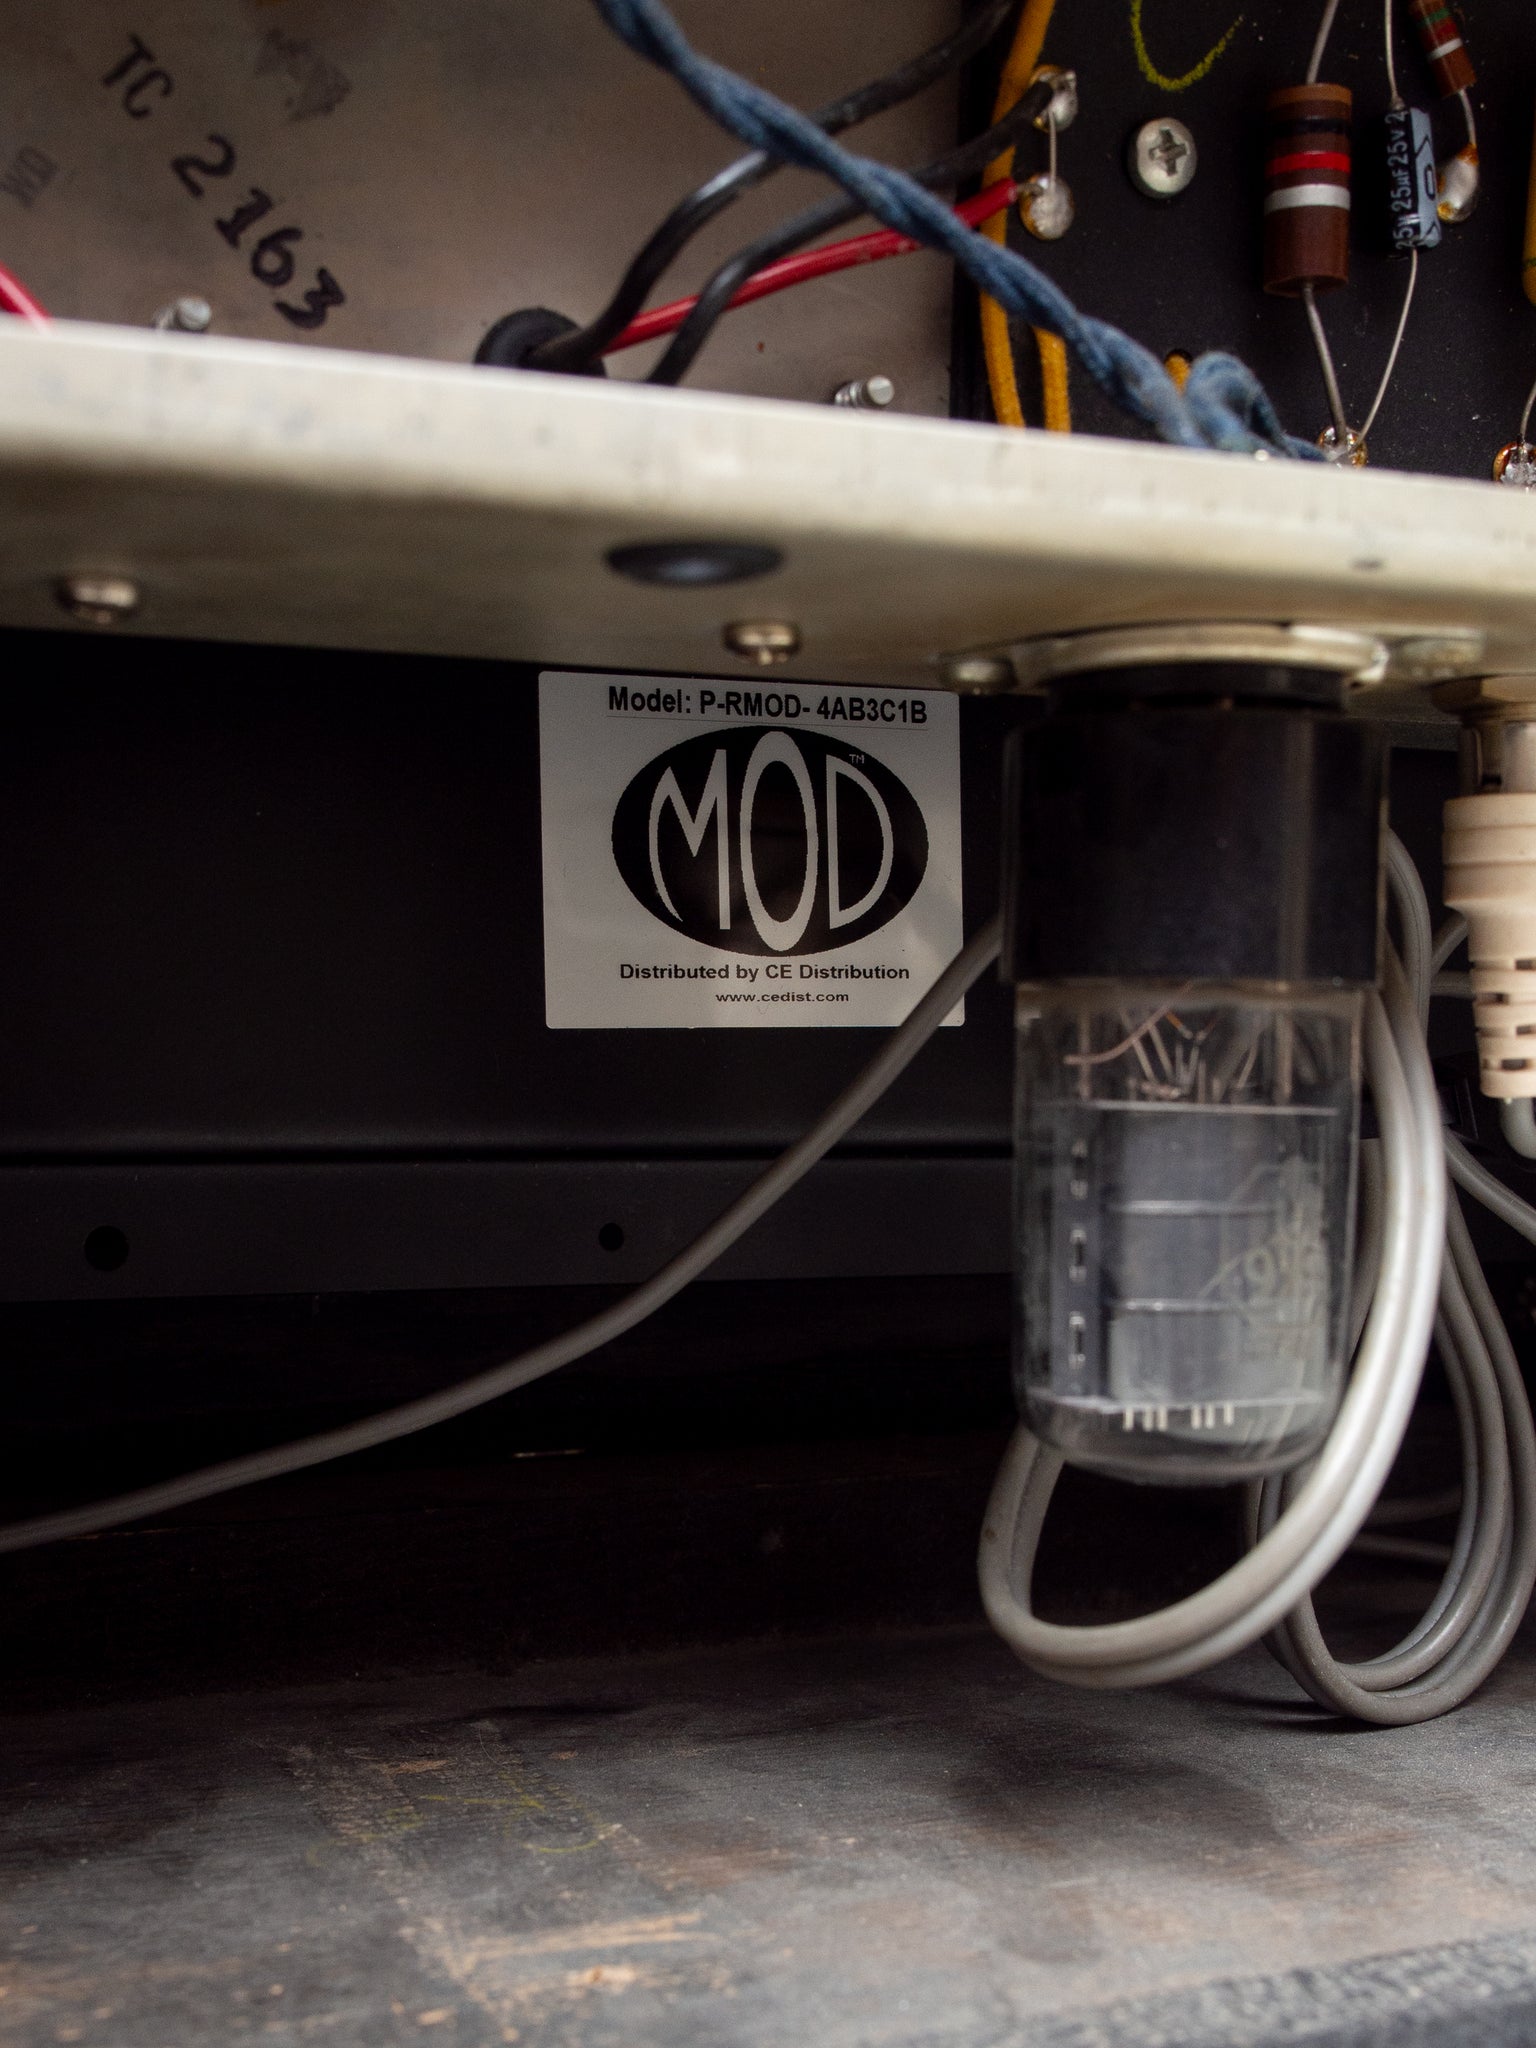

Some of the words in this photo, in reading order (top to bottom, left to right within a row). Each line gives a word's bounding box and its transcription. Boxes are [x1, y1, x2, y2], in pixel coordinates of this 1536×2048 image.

[103, 33, 174, 119] TC
[171, 134, 347, 330] 2163
[608, 686, 691, 714] Model:
[700, 689, 811, 718] P-RMOD-
[817, 696, 928, 724] 4AB3C1B
[648, 731, 894, 952] MOD
[620, 964, 730, 981] Distributed
[736, 964, 759, 983] by
[765, 965, 793, 980] CE
[800, 965, 910, 980] Distribution
[715, 991, 849, 1003] www.cedist.com
